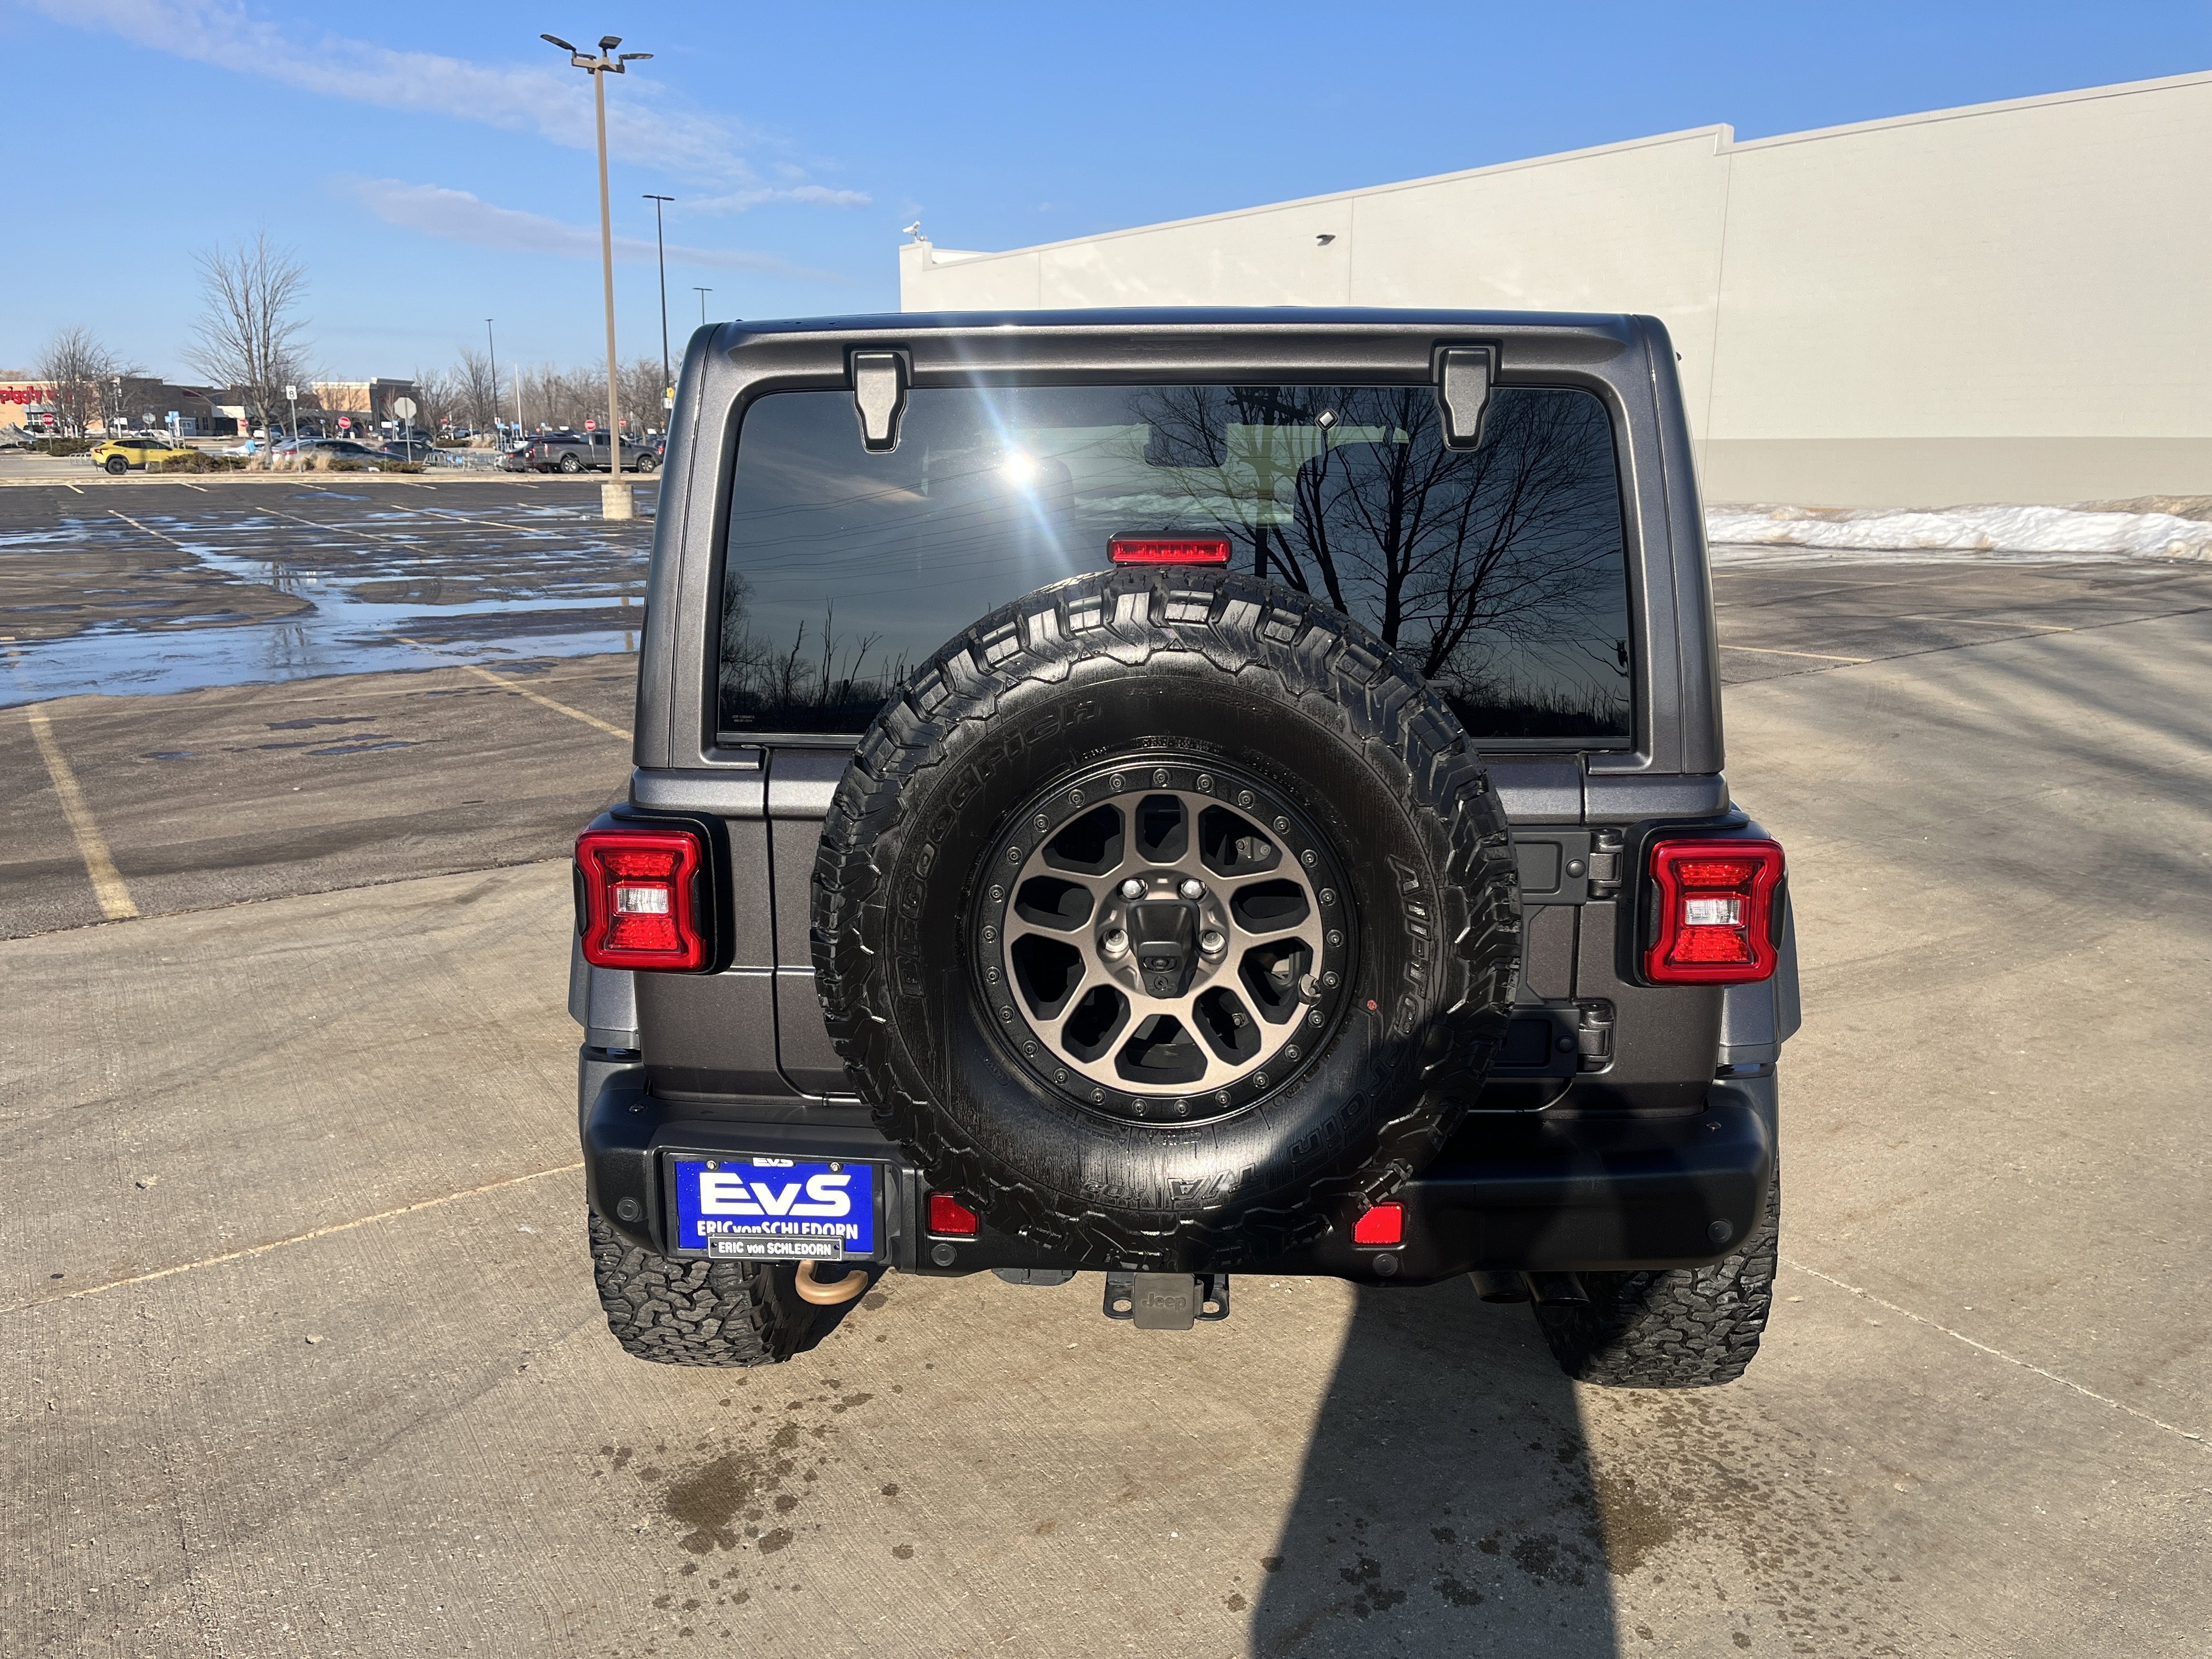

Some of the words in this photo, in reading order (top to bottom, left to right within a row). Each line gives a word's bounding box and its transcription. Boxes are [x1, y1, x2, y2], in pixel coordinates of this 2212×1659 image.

[718, 1242, 744, 1254] ERIC
[747, 1244, 765, 1254] von
[767, 1242, 831, 1255] SCHLEDORN
[1142, 1292, 1187, 1311] Jeep
